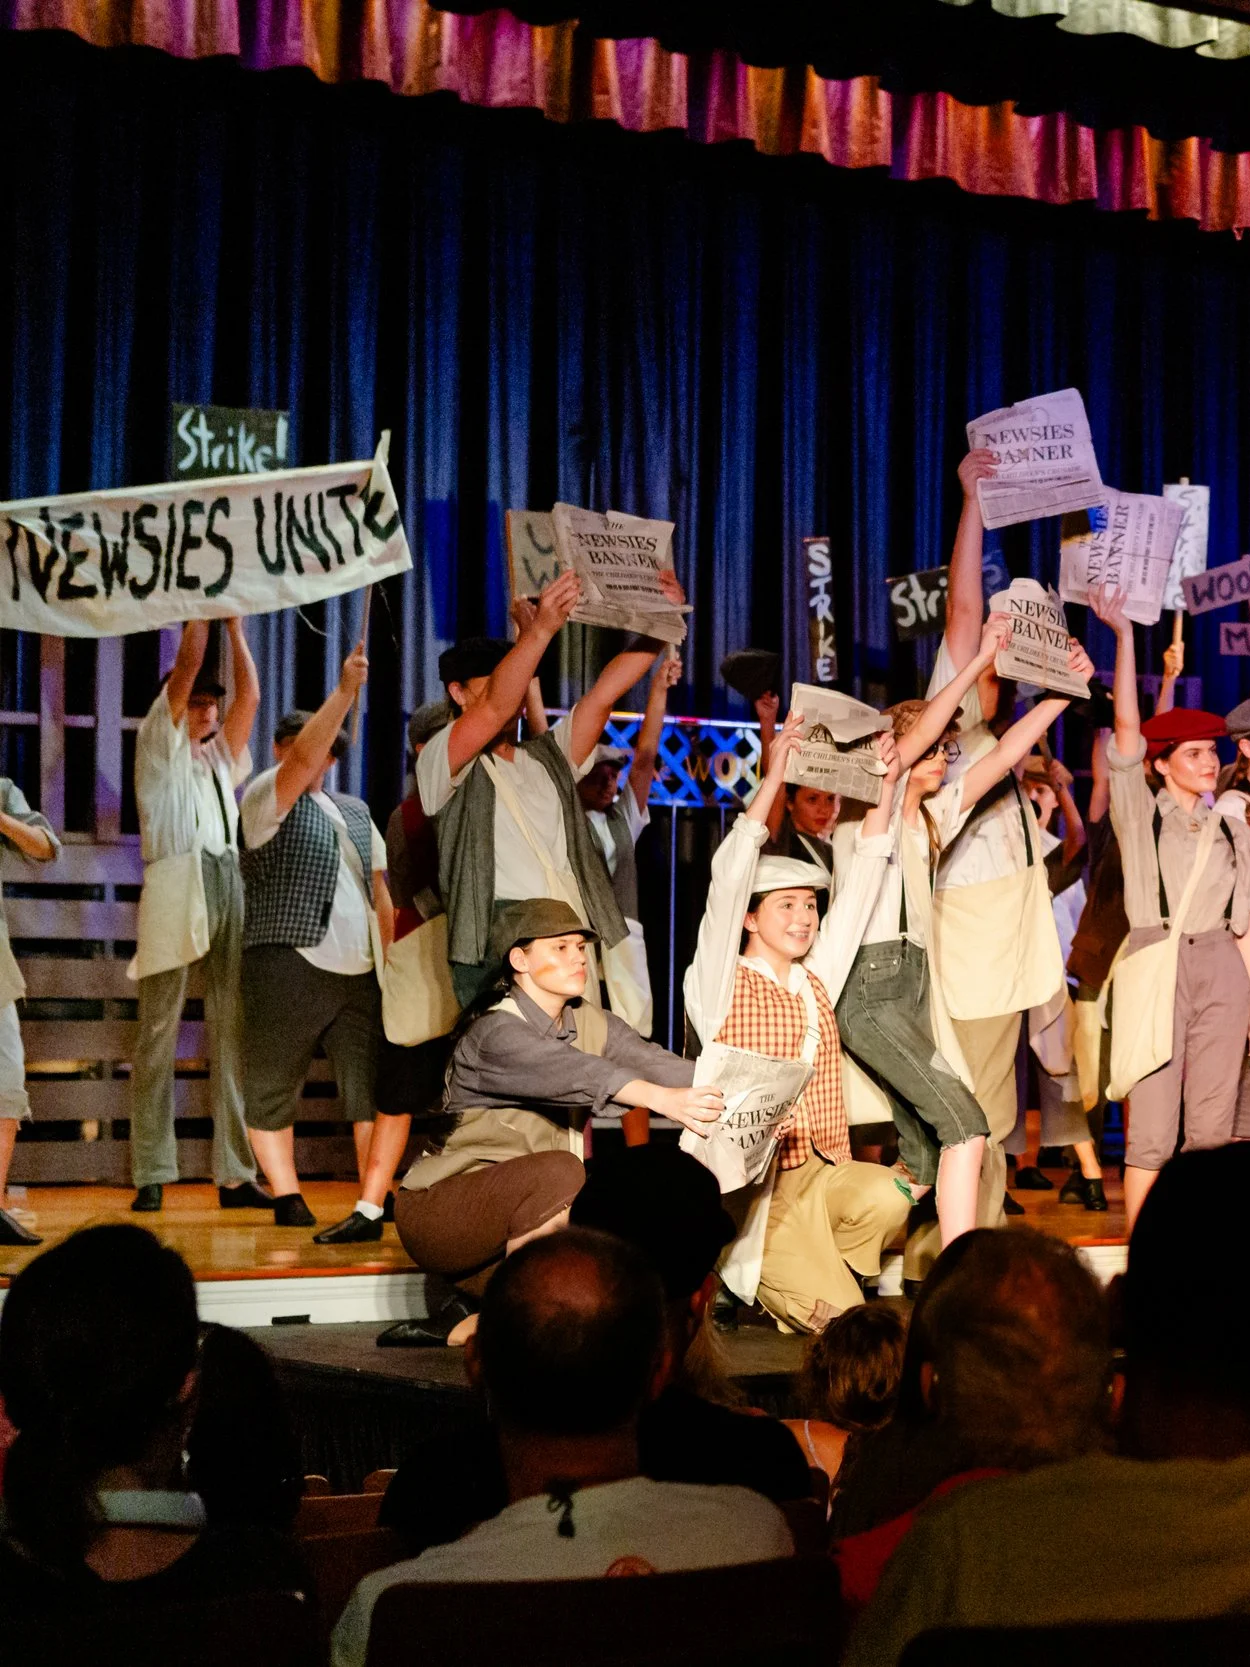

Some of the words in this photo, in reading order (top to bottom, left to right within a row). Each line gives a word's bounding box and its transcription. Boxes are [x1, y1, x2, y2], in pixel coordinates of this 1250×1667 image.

[177, 407, 288, 473] Strike!
[984, 423, 1075, 448] NEWSIES
[5, 497, 235, 604] NEWSIES
[573, 532, 658, 553] NEWSIES
[1106, 504, 1129, 585] BANNER
[807, 543, 836, 682] STRIKE
[1012, 618, 1073, 653] BANNER
[760, 1093, 776, 1104] THE
